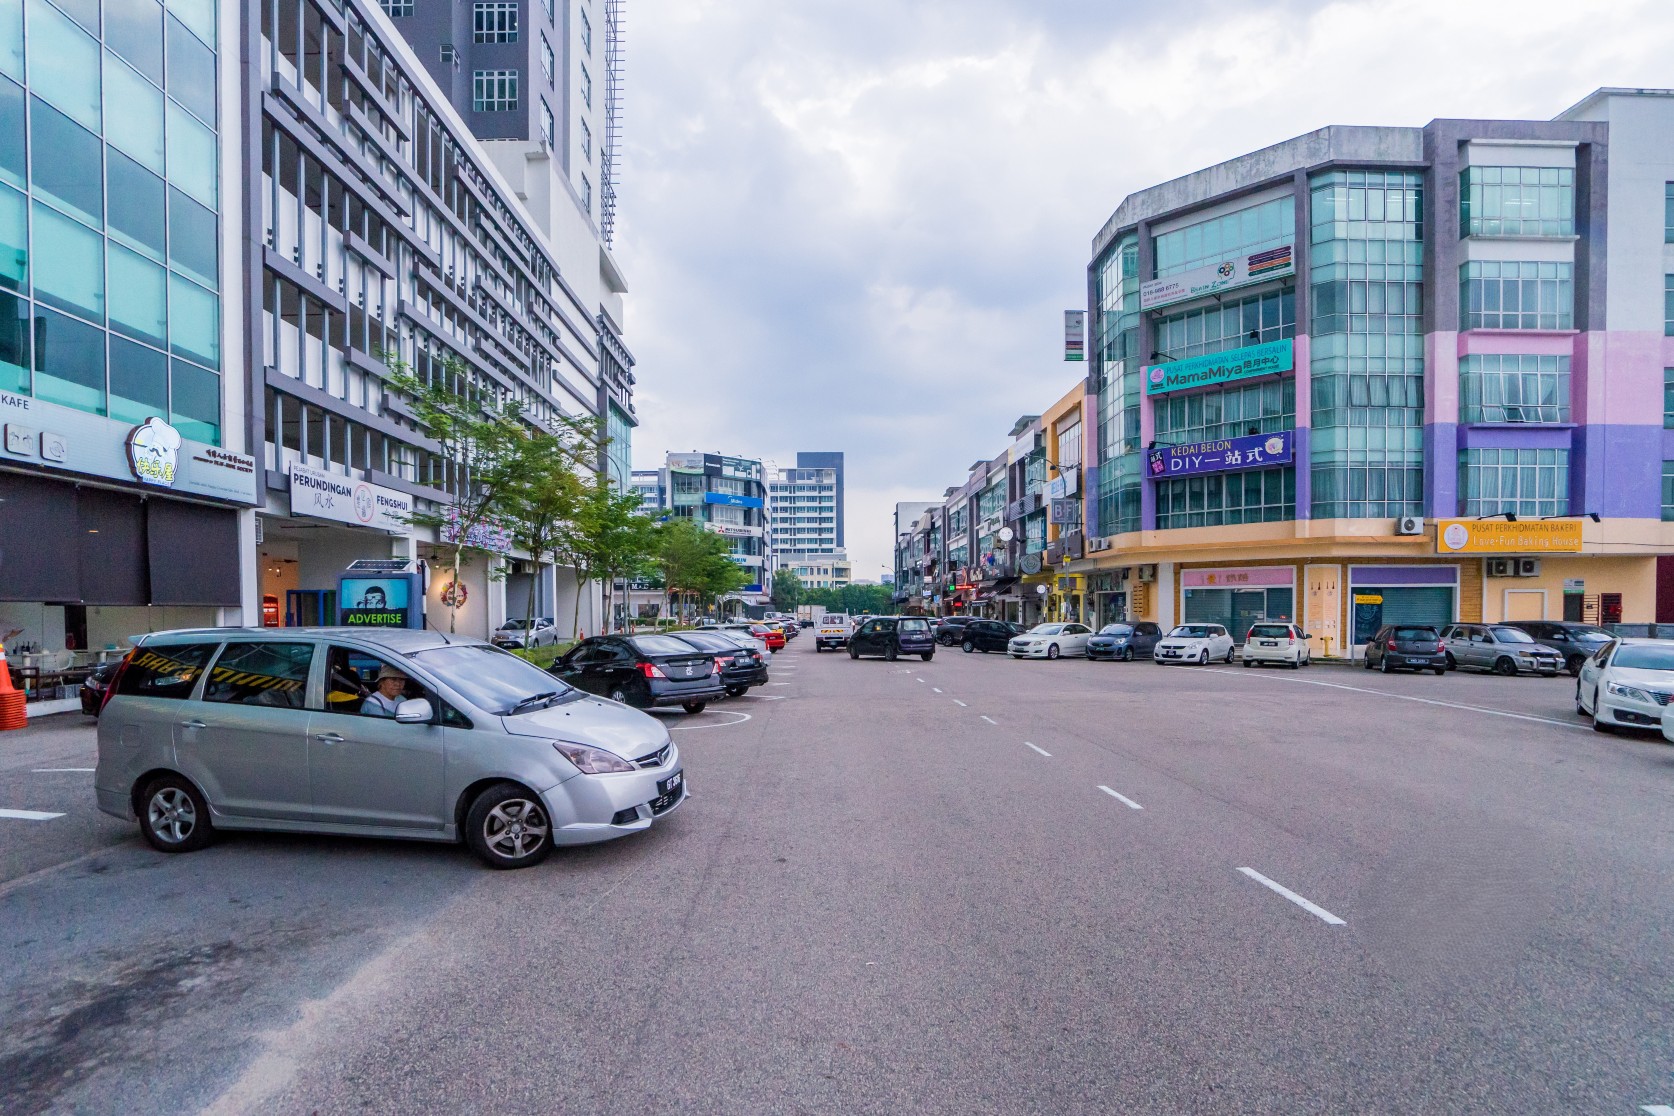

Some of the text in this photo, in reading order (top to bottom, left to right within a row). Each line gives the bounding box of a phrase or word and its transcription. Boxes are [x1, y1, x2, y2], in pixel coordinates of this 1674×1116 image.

[1256, 344, 1287, 357] BERSALIN
[1166, 364, 1243, 387] MamaMiya
[1, 394, 29, 410] KAFE
[1171, 441, 1231, 457] KEDAI BELON
[293, 473, 352, 498] PERUNDINGAN
[313, 492, 335, 509] 风水
[376, 495, 408, 511] FENGSHUI
[1472, 523, 1577, 532] PUSAT PERKHIDMATAN BAKERI
[1517, 535, 1549, 548] Baking
[1552, 536, 1579, 546] House
[347, 613, 402, 624] ADVERTISE
